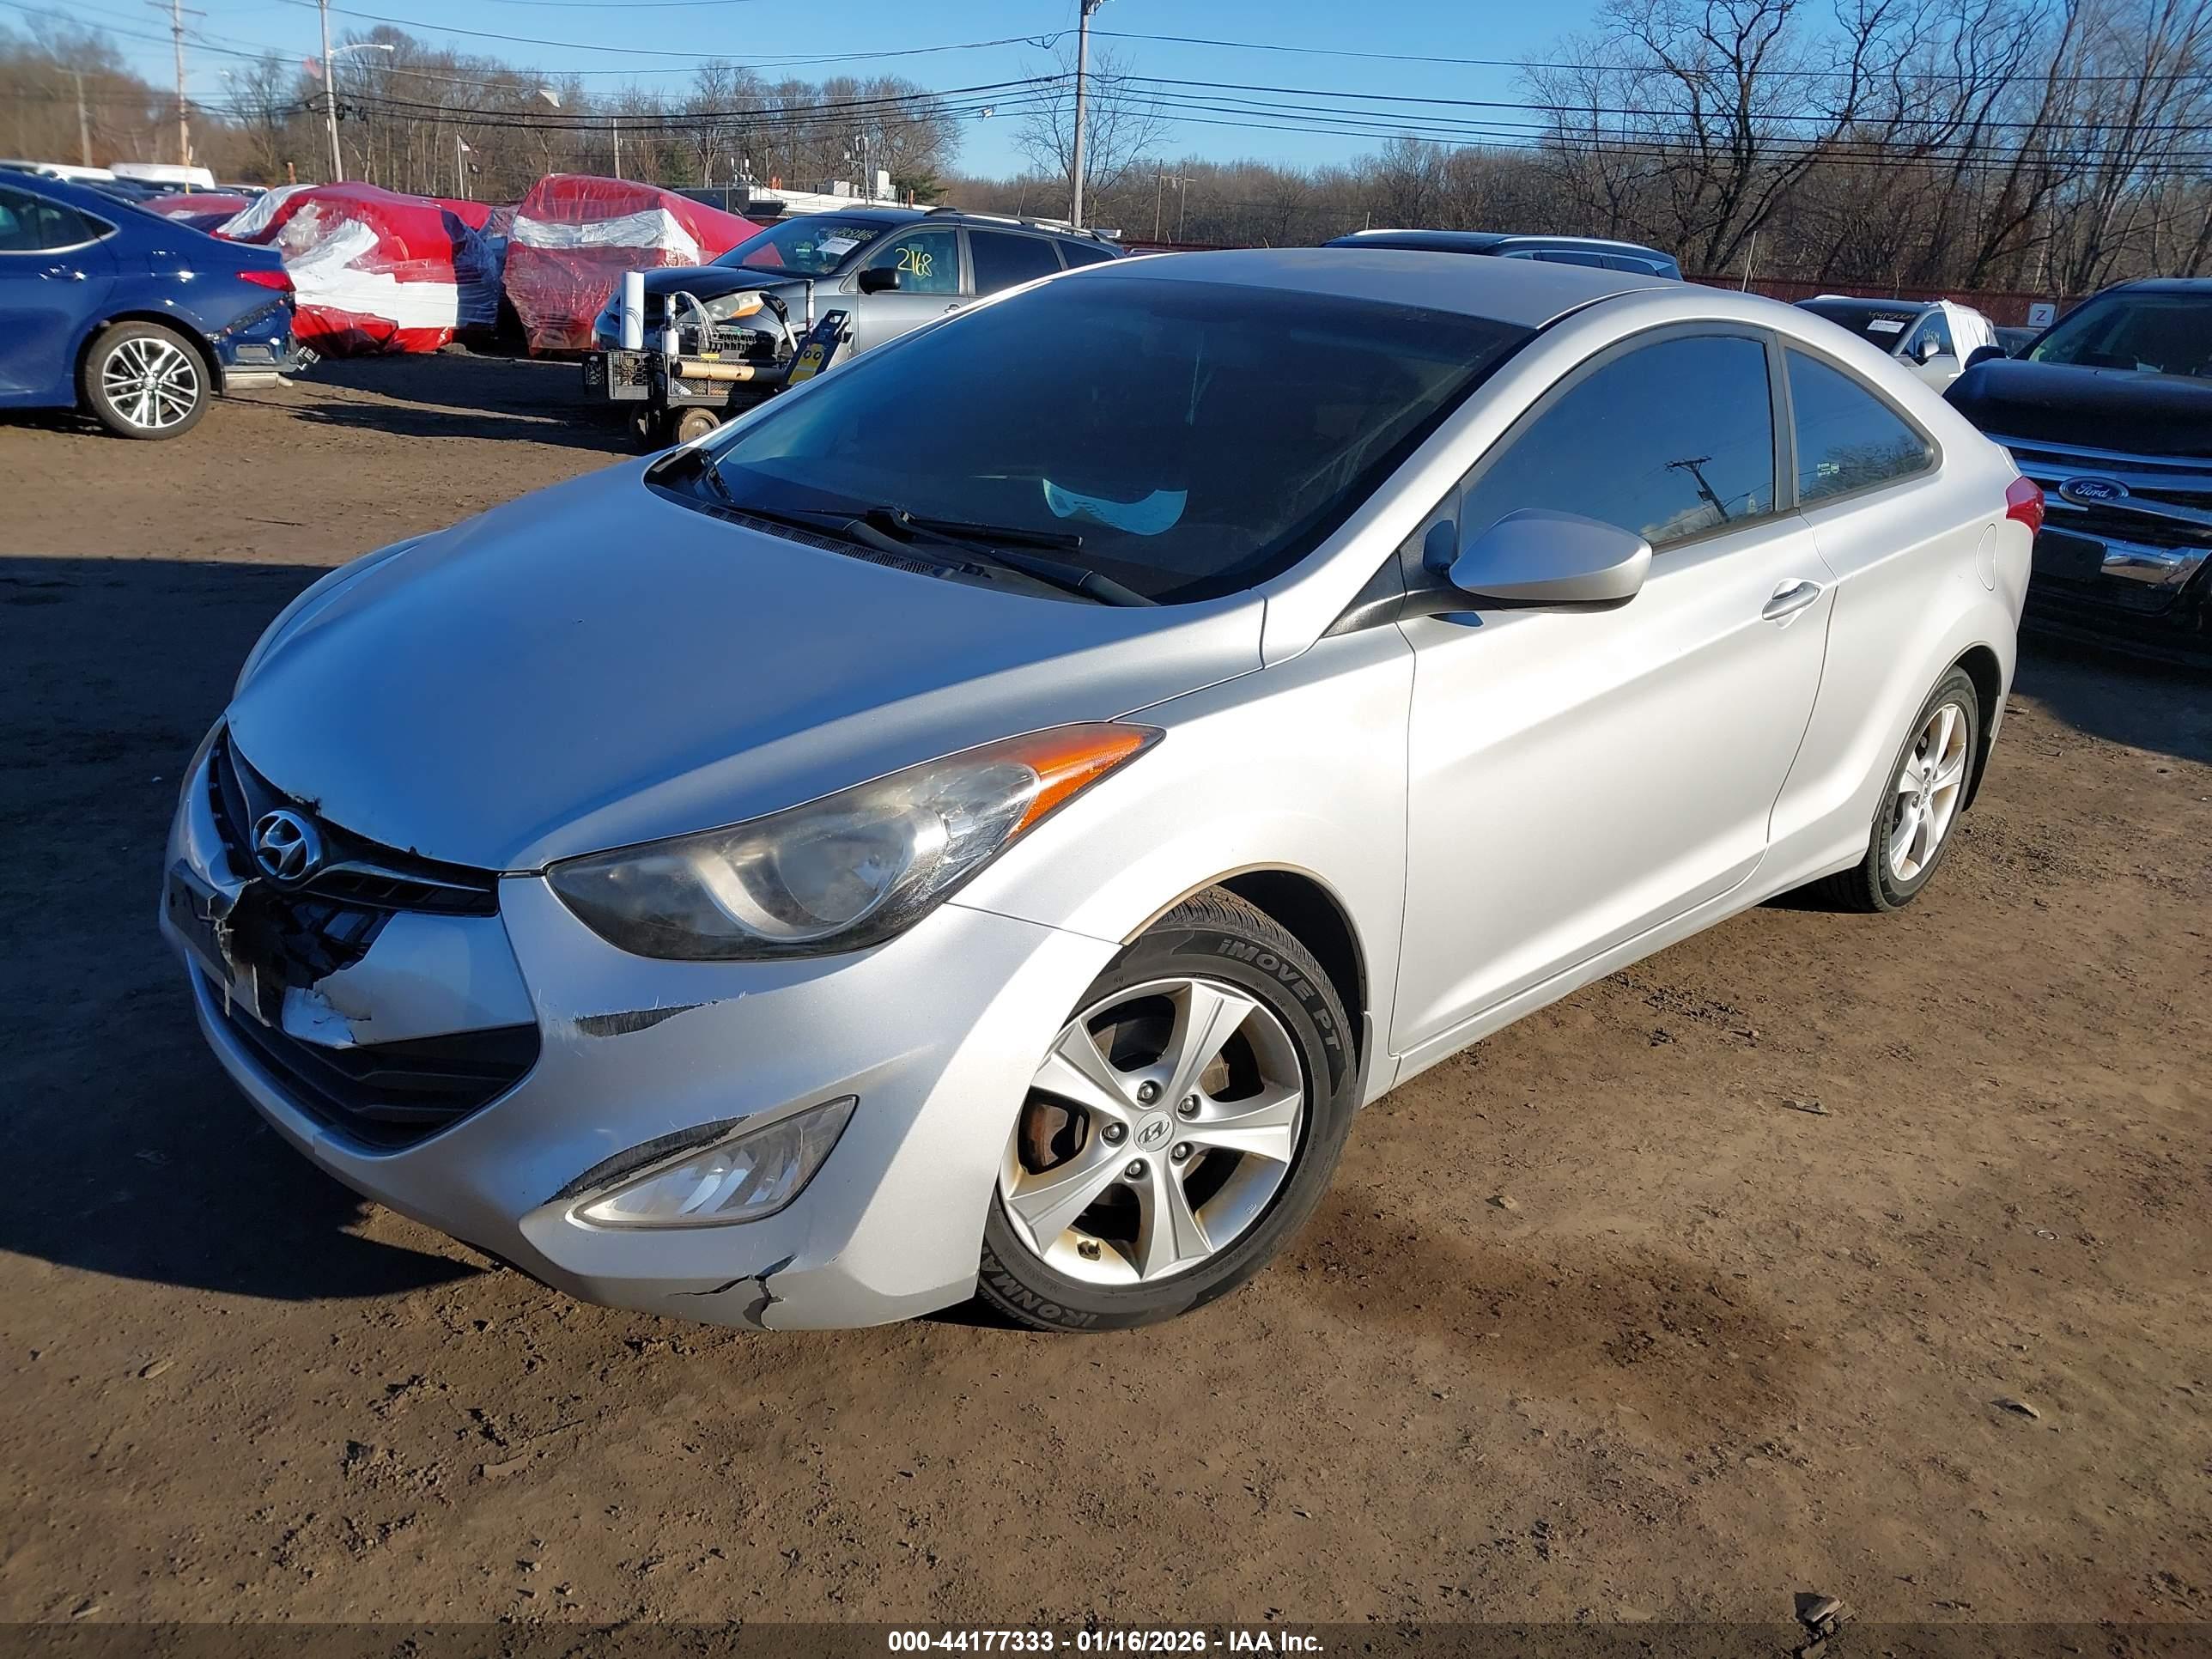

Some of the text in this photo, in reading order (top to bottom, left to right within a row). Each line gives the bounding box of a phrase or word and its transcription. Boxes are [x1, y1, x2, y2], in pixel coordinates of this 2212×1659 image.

[895, 248, 933, 276] 2168
[2036, 310, 2047, 321] Z
[2075, 483, 2110, 498] Ford
[1216, 939, 1316, 1001] iMOVE
[1313, 1008, 1340, 1050] PT
[981, 1246, 1098, 1327] IRONMA
